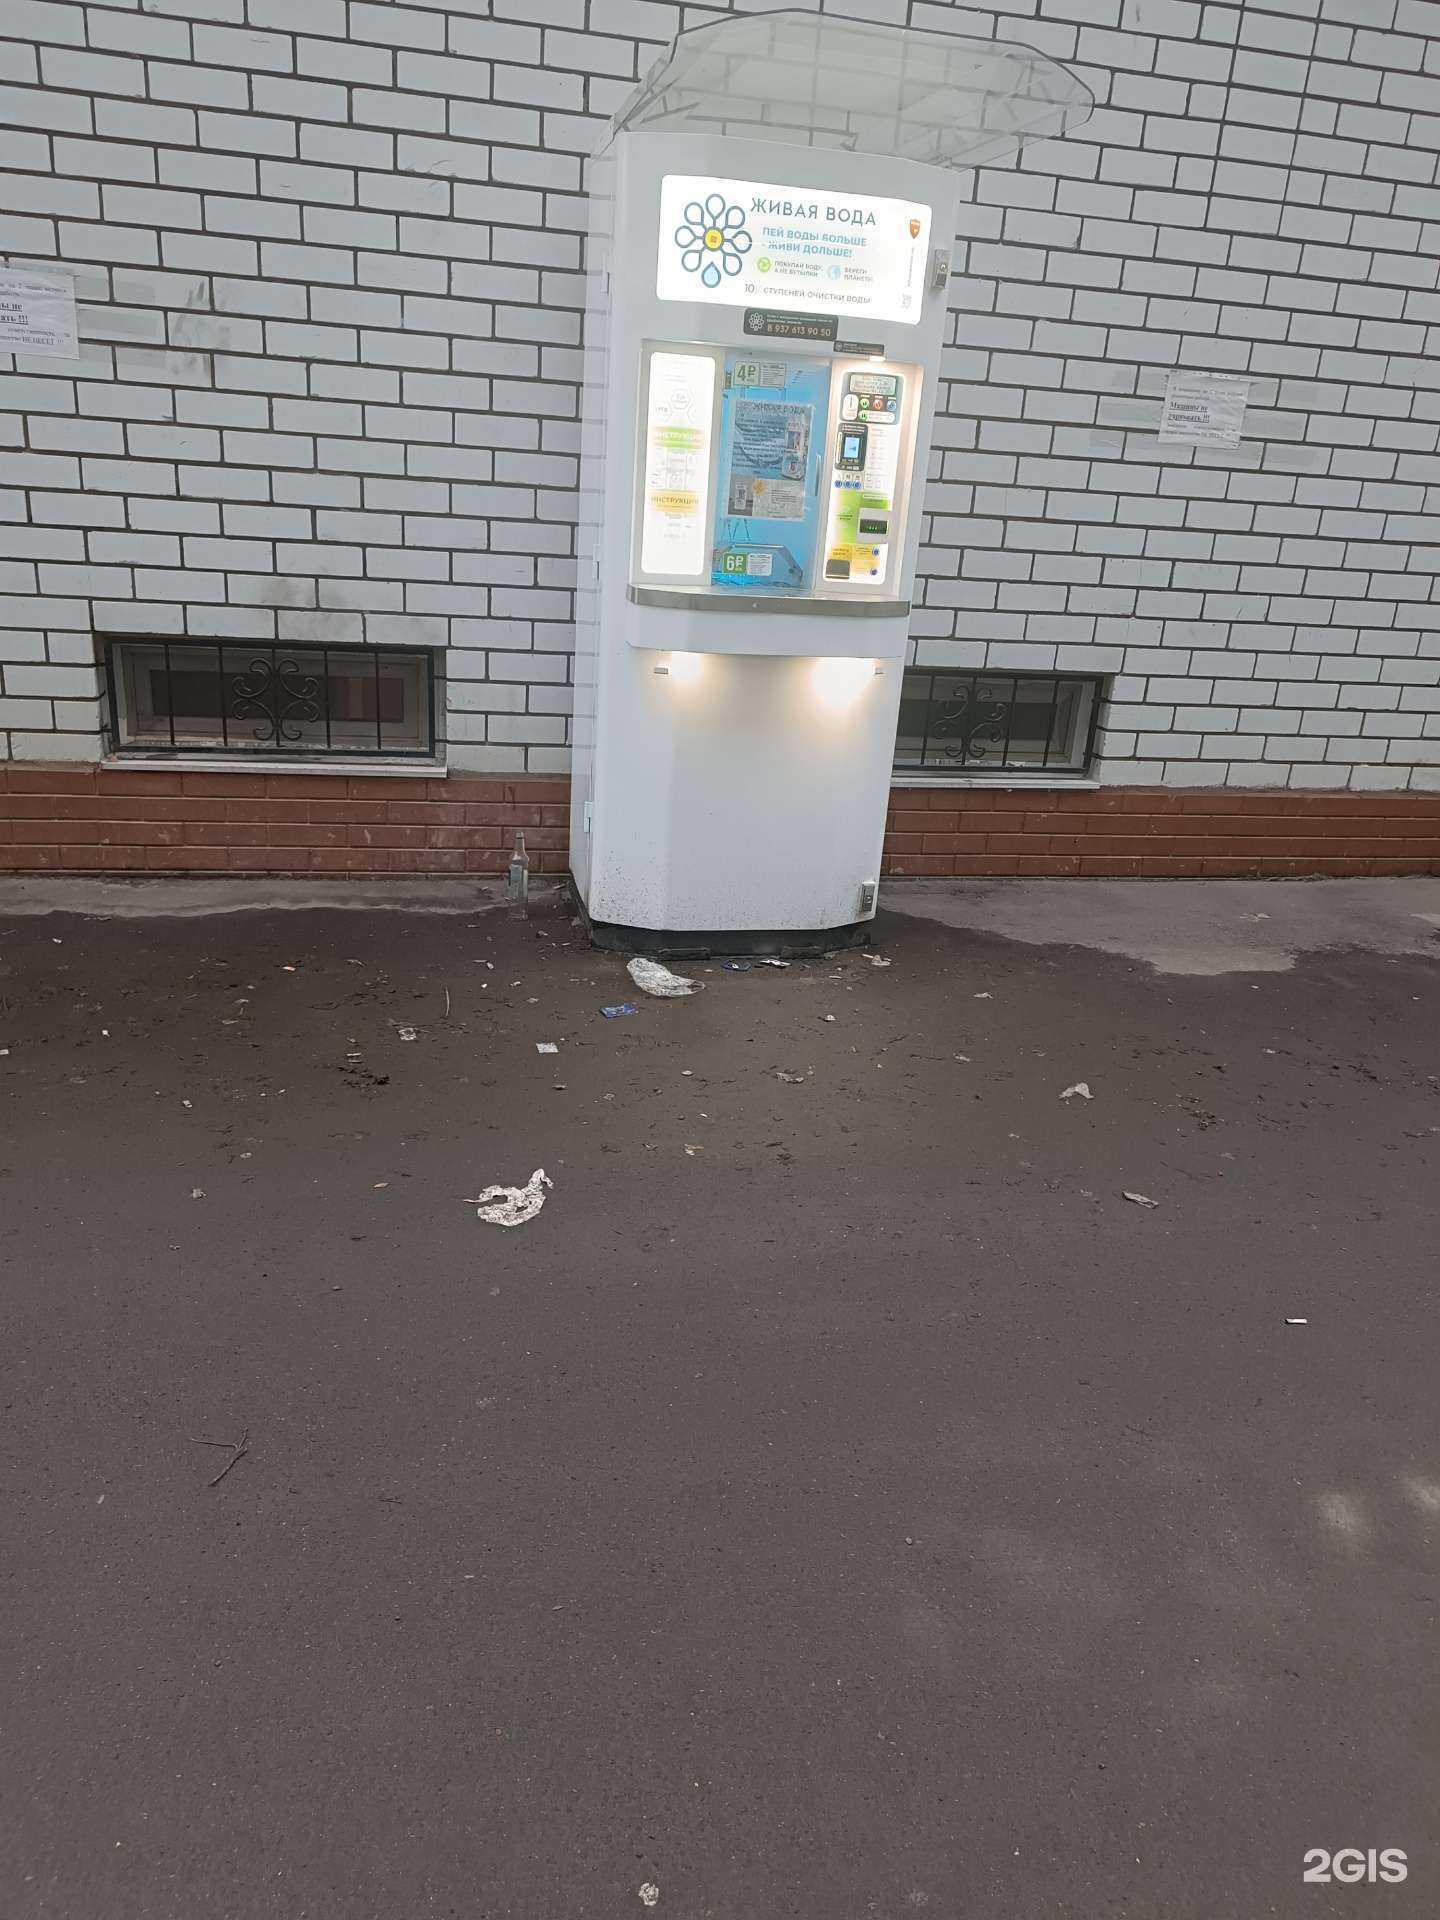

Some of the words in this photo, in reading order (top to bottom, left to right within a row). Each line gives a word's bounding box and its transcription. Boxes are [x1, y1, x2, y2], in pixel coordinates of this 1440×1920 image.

[751, 197, 818, 220] ЖИВАЯ
[826, 206, 877, 227] ВОДА
[762, 226, 784, 239] ПЕЙ
[787, 230, 819, 242] ВОДЫ
[822, 234, 868, 247] БОЛЬШЕ
[768, 241, 801, 253] ЖИВИ
[803, 244, 853, 258] ДОЛЬШЕ!
[763, 287, 805, 298] СТУПЕНЕЙ
[807, 291, 845, 302] ОЧИСТКИ
[846, 294, 871, 304] ВОДЫ
[775, 324, 789, 334] 937
[791, 325, 805, 335] 613
[807, 327, 818, 336] 90
[820, 328, 831, 337] 50
